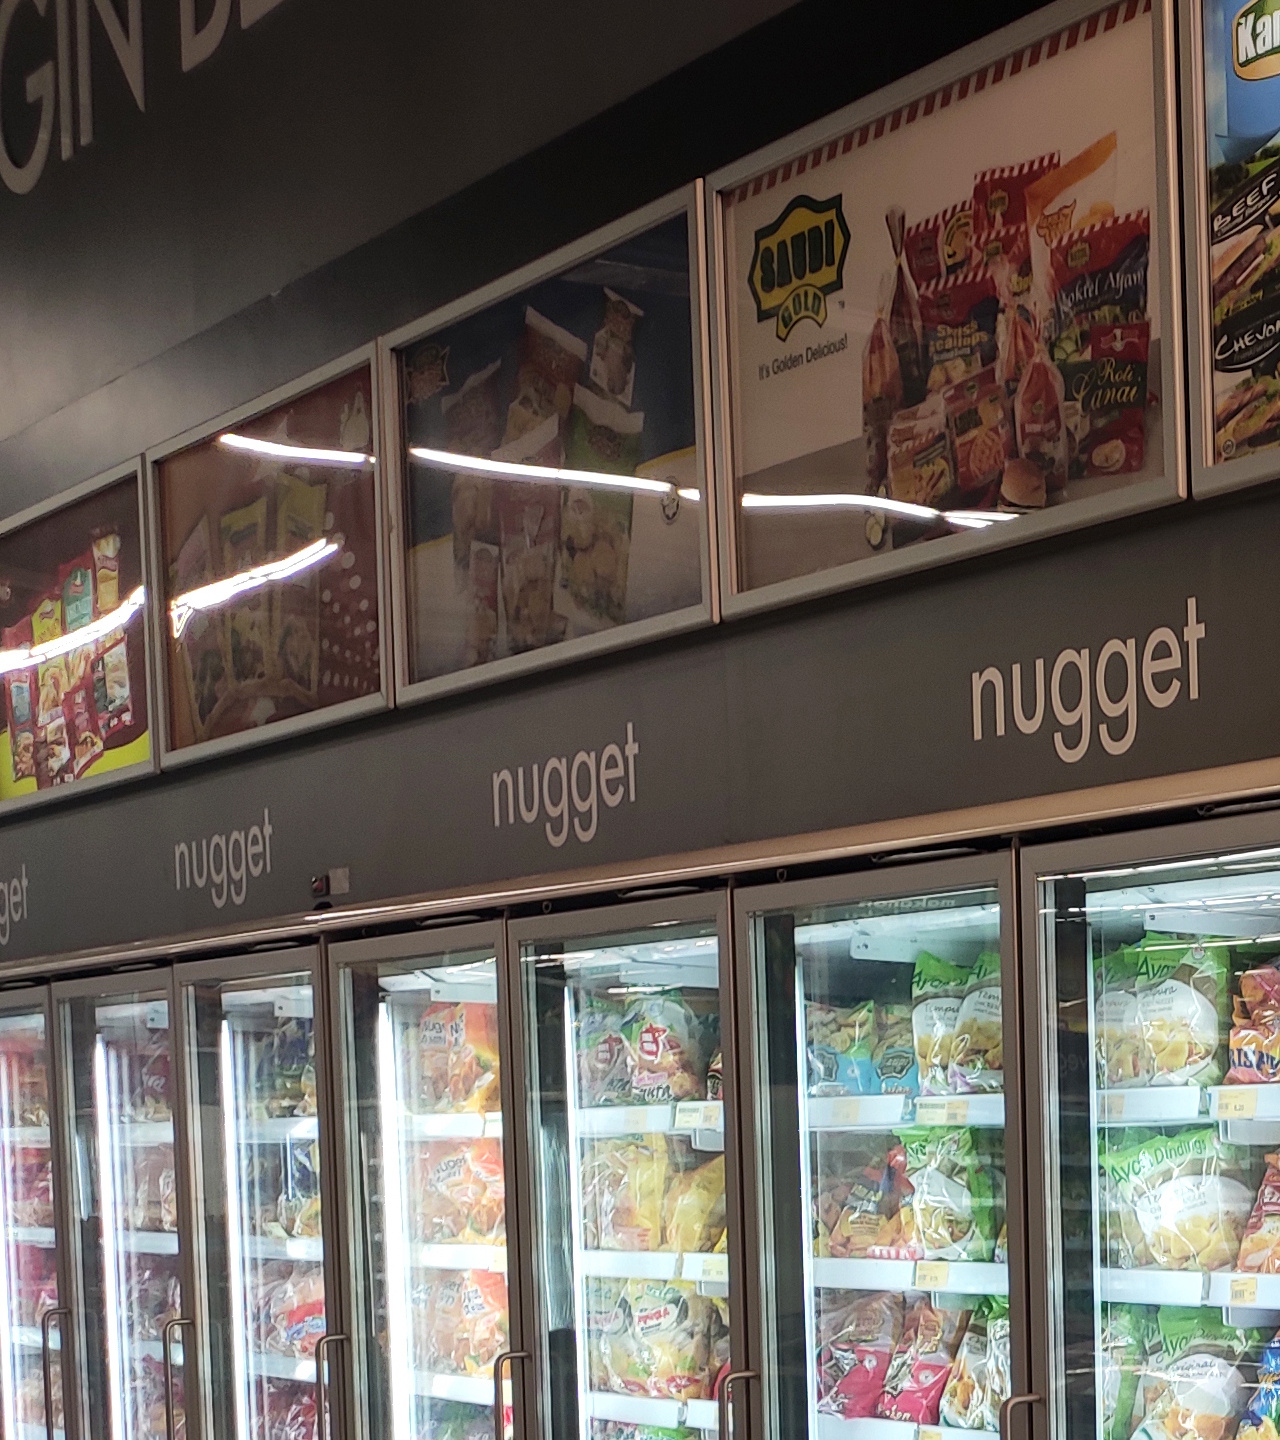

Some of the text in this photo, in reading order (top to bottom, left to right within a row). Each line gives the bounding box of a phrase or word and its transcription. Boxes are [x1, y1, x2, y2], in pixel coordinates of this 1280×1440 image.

[1213, 173, 1277, 232] BEEF
[760, 219, 836, 293] SAUDI
[780, 290, 823, 330] GOLD
[758, 333, 848, 381] It's Golden Delicious!
[970, 596, 1206, 763] nugget
[492, 722, 640, 847] nugget
[174, 808, 273, 908] nugget
